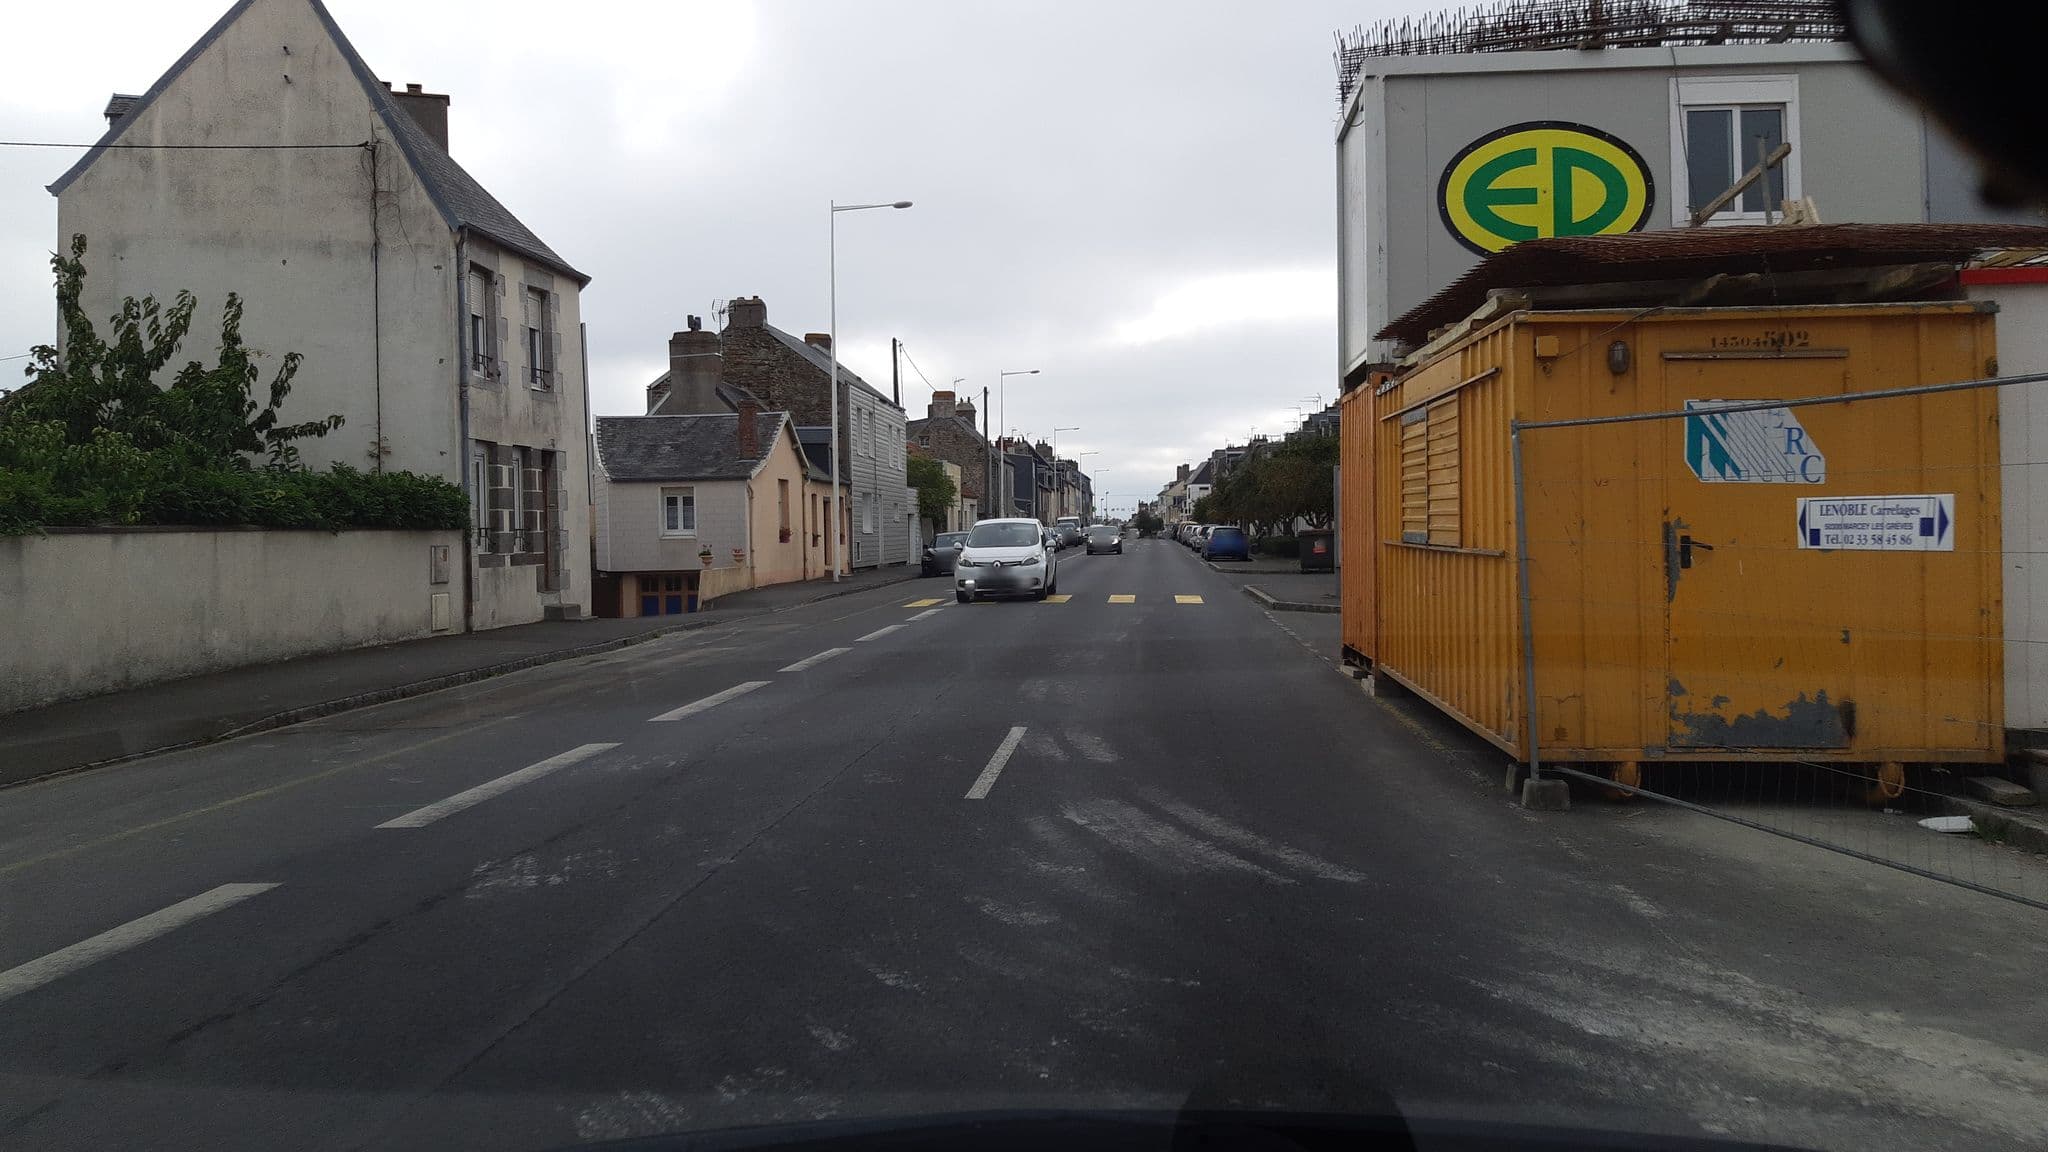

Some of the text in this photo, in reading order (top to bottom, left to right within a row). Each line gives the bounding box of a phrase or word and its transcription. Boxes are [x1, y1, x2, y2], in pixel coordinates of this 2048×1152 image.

[1463, 146, 1629, 243] ED
[1820, 504, 1921, 518] LENOBLE Carrelages
[1843, 534, 1855, 545] 02
[1856, 534, 1869, 545] 33
[1871, 534, 1884, 545] 58
[1885, 535, 1898, 545] 45
[1900, 534, 1913, 545] 86
